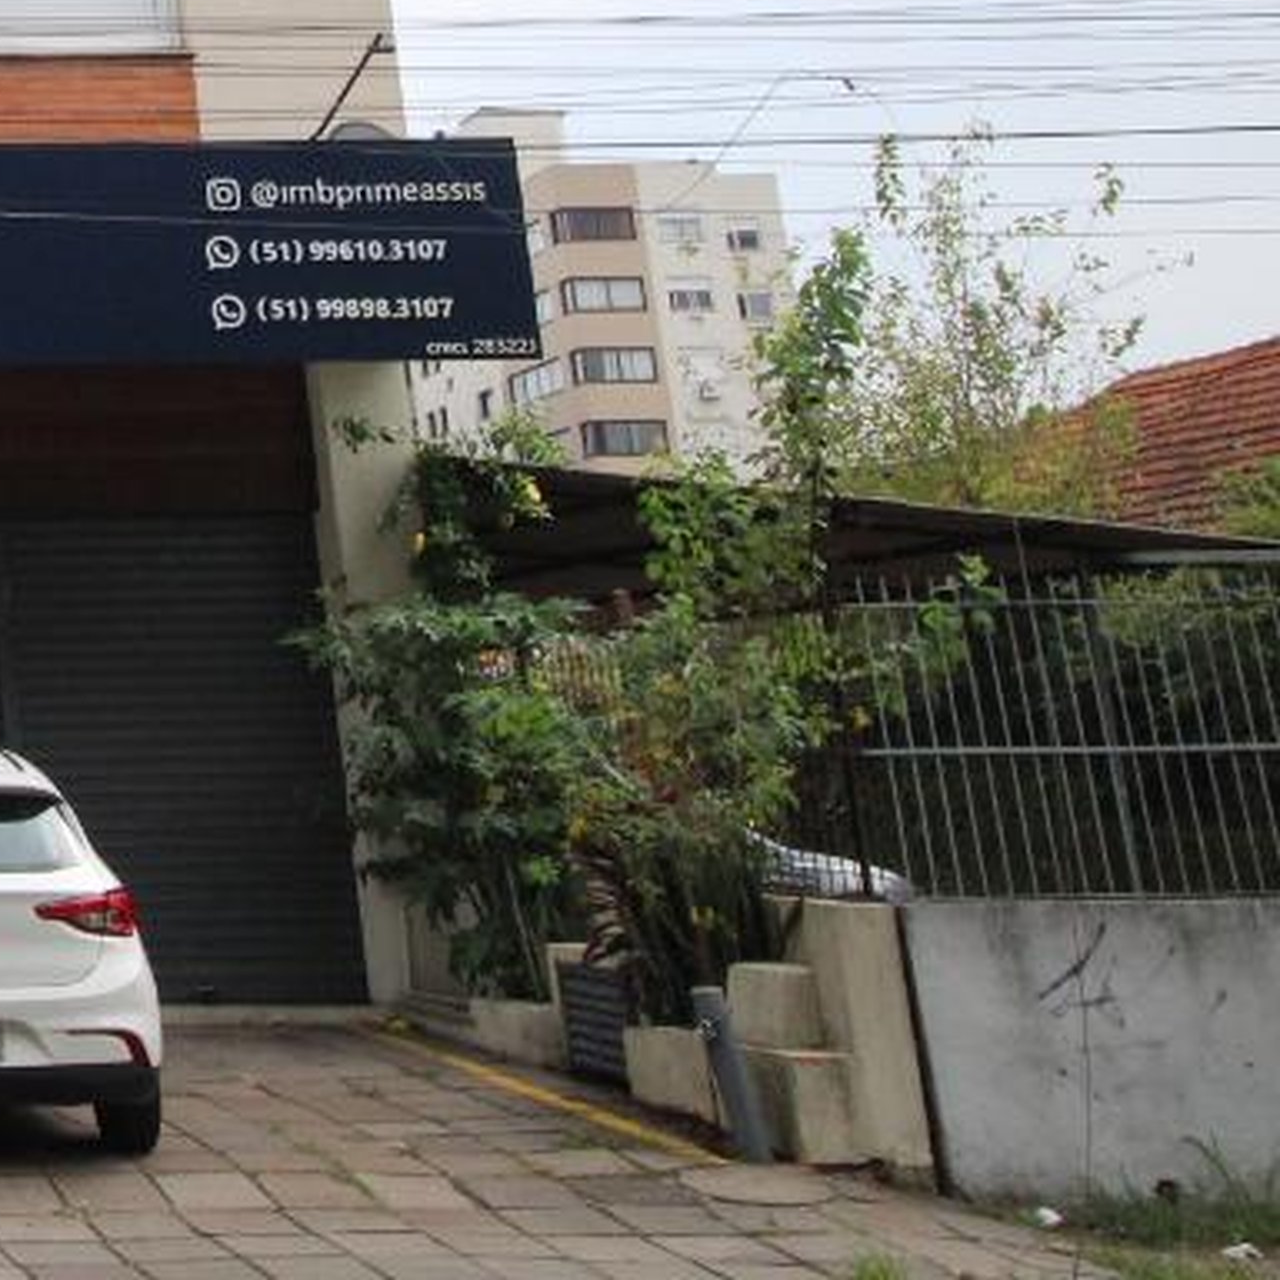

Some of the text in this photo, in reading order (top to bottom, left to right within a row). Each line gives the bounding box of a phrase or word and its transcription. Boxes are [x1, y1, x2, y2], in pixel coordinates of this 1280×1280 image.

[251, 177, 486, 208] @imbprimeassis
[249, 239, 447, 264] (51) 99610.3107
[256, 297, 454, 322] (51) 99898.3107
